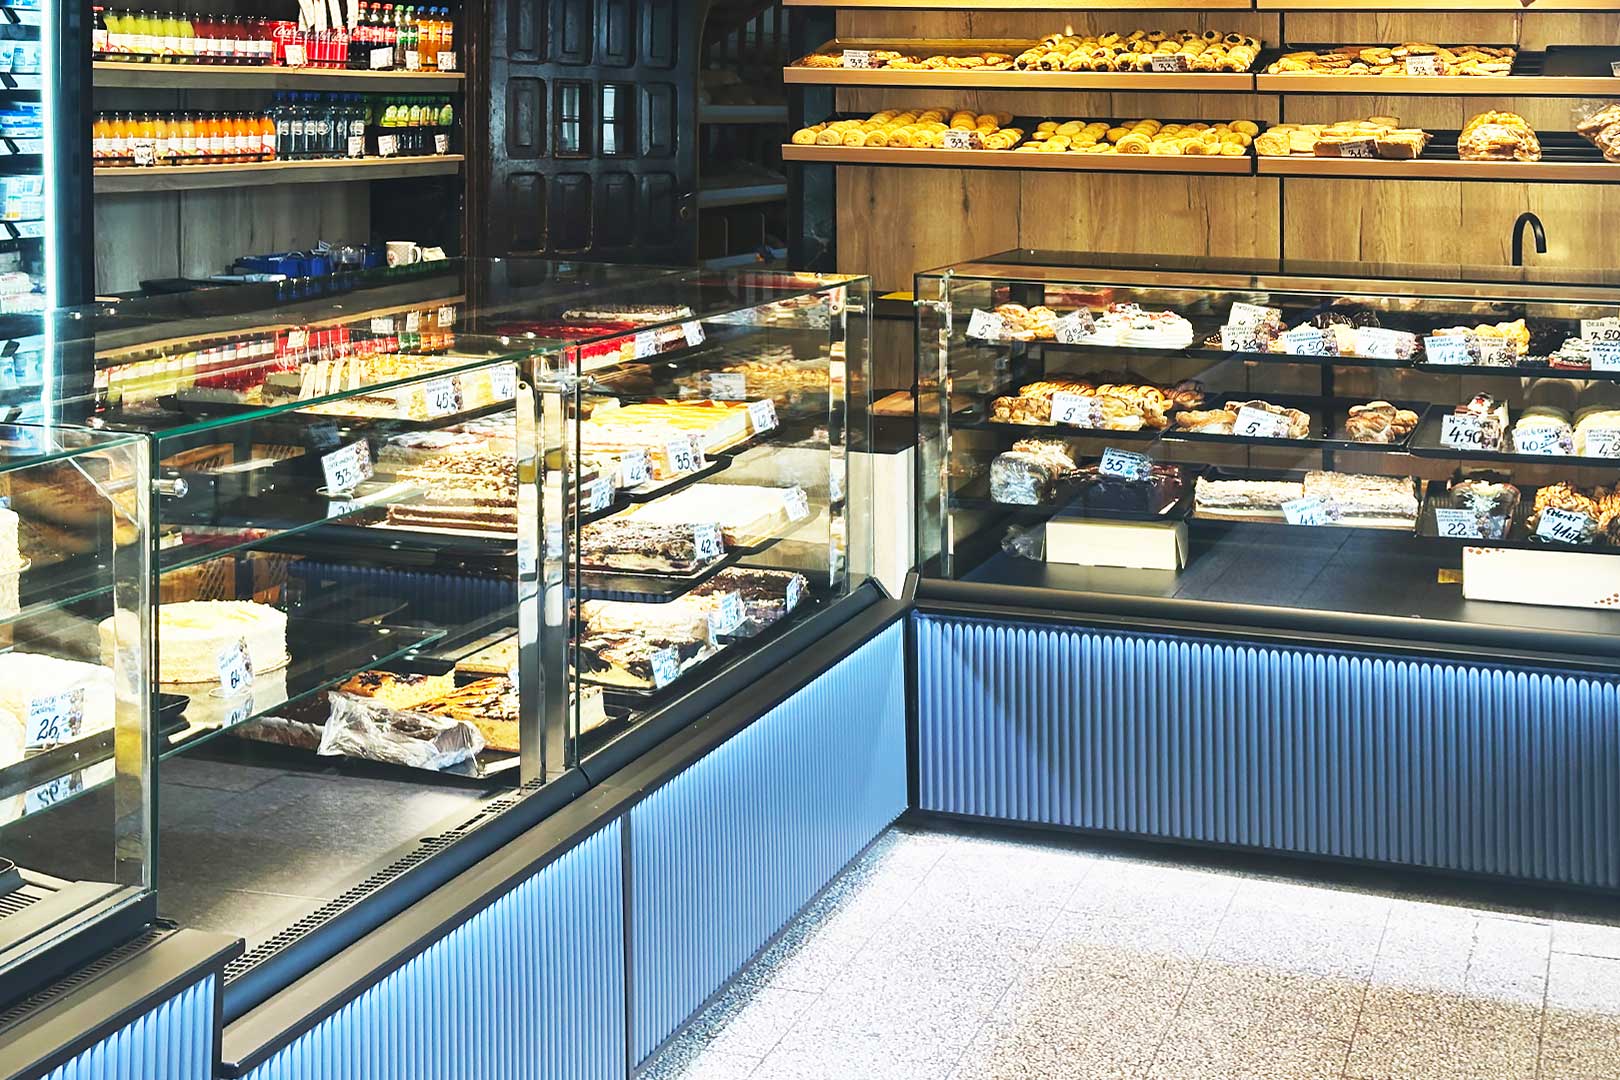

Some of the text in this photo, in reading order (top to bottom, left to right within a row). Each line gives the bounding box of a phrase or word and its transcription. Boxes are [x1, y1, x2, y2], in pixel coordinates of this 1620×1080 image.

[437, 392, 450, 410] 45
[1063, 408, 1076, 422] 5
[1246, 422, 1261, 435] 5
[1449, 426, 1483, 444] 4.90
[675, 452, 691, 470] 35
[1104, 458, 1124, 473] 35
[335, 468, 353, 487] 33
[1447, 522, 1468, 537] 22
[701, 538, 712, 555] 42
